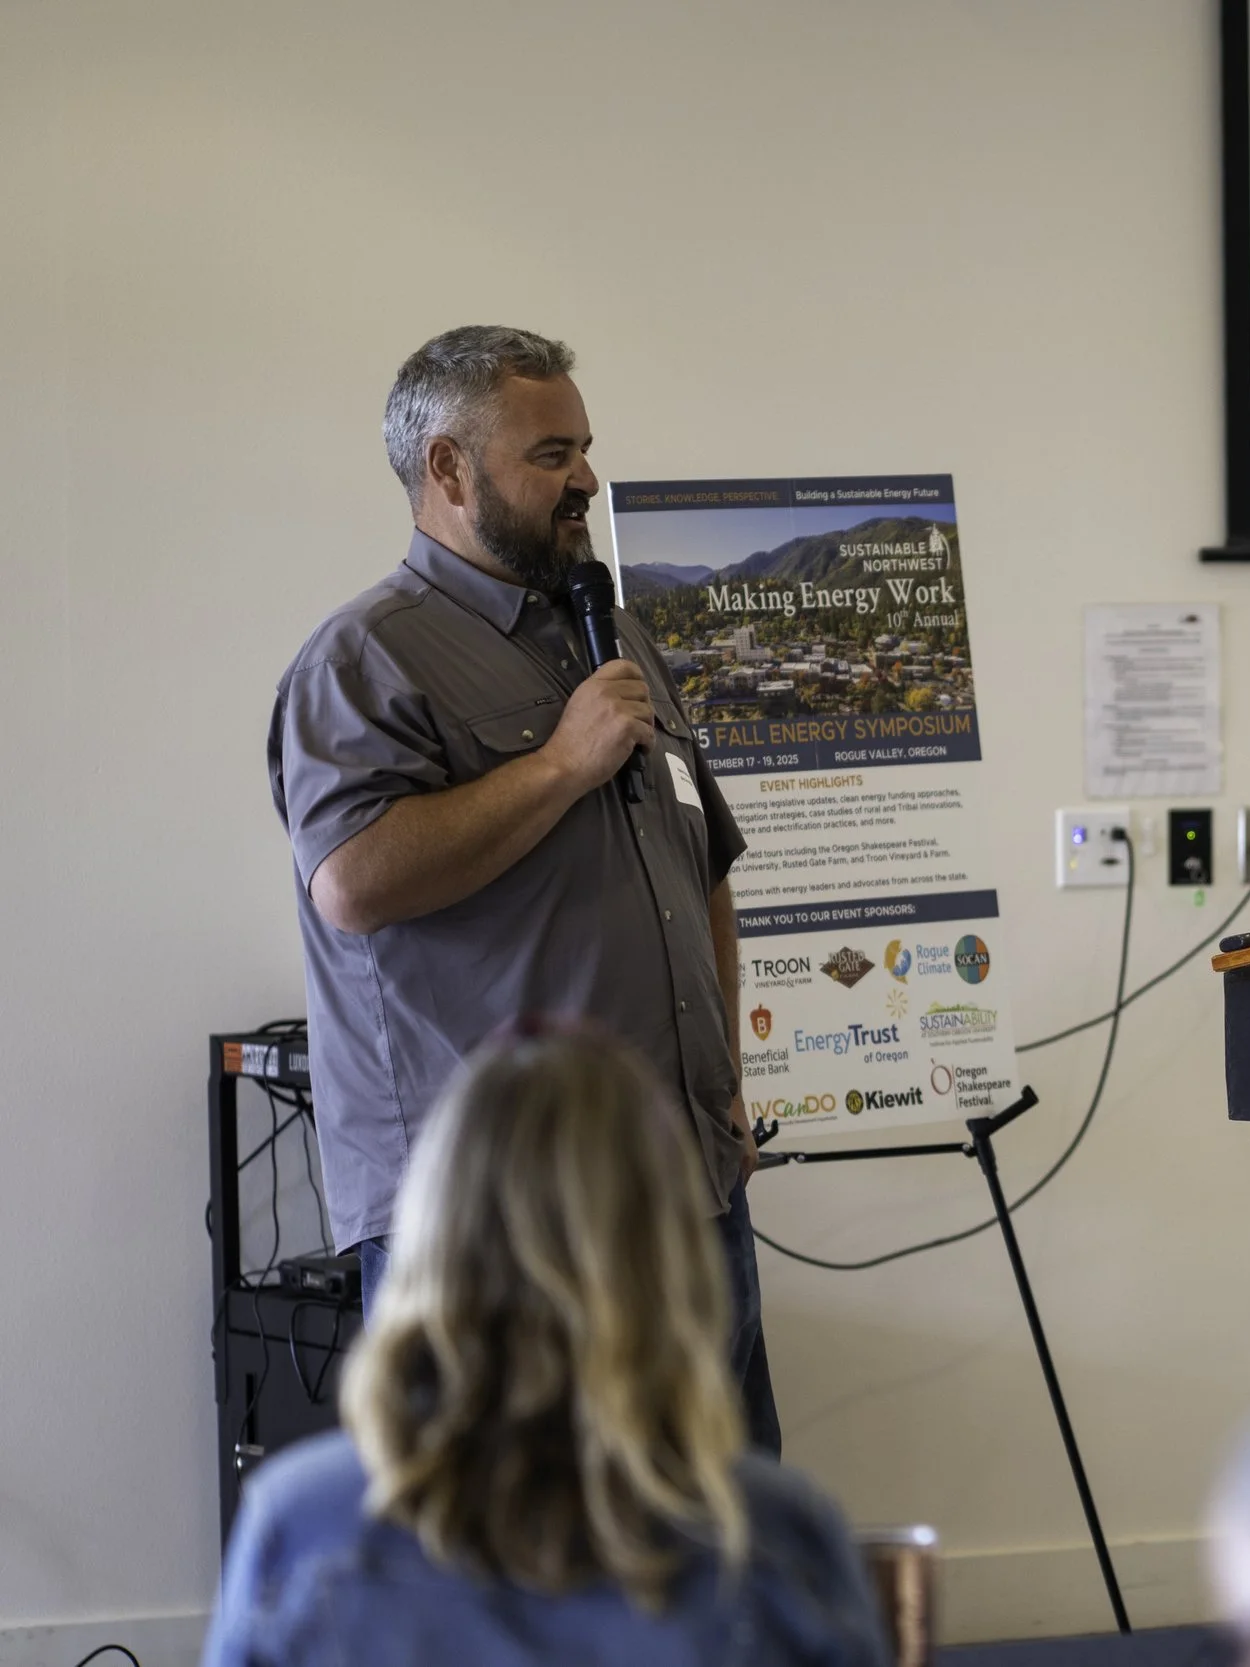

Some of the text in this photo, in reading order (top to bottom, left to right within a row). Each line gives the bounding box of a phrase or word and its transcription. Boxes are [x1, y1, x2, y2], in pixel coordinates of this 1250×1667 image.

[795, 490, 828, 501] Building
[836, 488, 881, 499] Sustainable
[884, 488, 911, 499] Energy
[913, 487, 939, 497] Future
[839, 542, 926, 557] SUSTAINABLE
[863, 558, 942, 572] NORTHWEST
[707, 576, 956, 617] Making Energy Work
[887, 610, 959, 628] 10th Annual
[715, 725, 764, 747] FALL
[769, 720, 848, 744] ENERGY
[854, 714, 971, 740] SYMPOSIUM
[706, 758, 744, 769] TEMBER
[746, 757, 755, 767] 17
[777, 754, 799, 765] 2025
[834, 746, 947, 762] ROGUE VALLEY, OREGON
[760, 775, 863, 793] EVENT HIGHLIGHTS
[736, 801, 768, 811] covering
[769, 798, 805, 808] legislative
[840, 794, 859, 803] clean
[861, 793, 886, 802] energy
[888, 791, 915, 800] funding
[809, 810, 825, 818] case
[827, 807, 853, 816] studies
[855, 807, 863, 815] of
[864, 806, 881, 814] rural
[899, 803, 918, 811] Tribal
[758, 826, 771, 834] and
[773, 822, 821, 832] electrification
[860, 818, 873, 826] and
[747, 851, 761, 859] field
[764, 849, 782, 858] tours
[784, 847, 816, 856] including
[818, 845, 830, 853] the
[832, 844, 859, 853] Oregon
[861, 840, 907, 850] Shakespeare
[783, 860, 807, 869] Rusted
[809, 858, 826, 867] Gate
[851, 855, 864, 863] and
[866, 854, 888, 862] Troon
[889, 851, 921, 861] Vineyard
[732, 888, 763, 898] ceptions
[765, 886, 780, 895] with
[782, 885, 808, 894] energy
[809, 882, 835, 892] leaders
[837, 881, 851, 889] and
[853, 878, 890, 888] advocates
[891, 876, 909, 885] from
[911, 875, 933, 884] across
[935, 873, 947, 881] the
[740, 904, 916, 928] THANK YOU TO OUR EVENT SPONSORS:
[916, 944, 949, 961] Rogue
[957, 953, 987, 966] SOCAN
[752, 957, 811, 977] TROON
[918, 961, 952, 975] Climate
[742, 1048, 788, 1064] Beneficial
[864, 1051, 908, 1063] of Oregon
[744, 1063, 789, 1077] State Bank
[955, 1066, 987, 1079] Oregon
[957, 1079, 1011, 1093] Shakespeare
[865, 1087, 923, 1110] Kiewit
